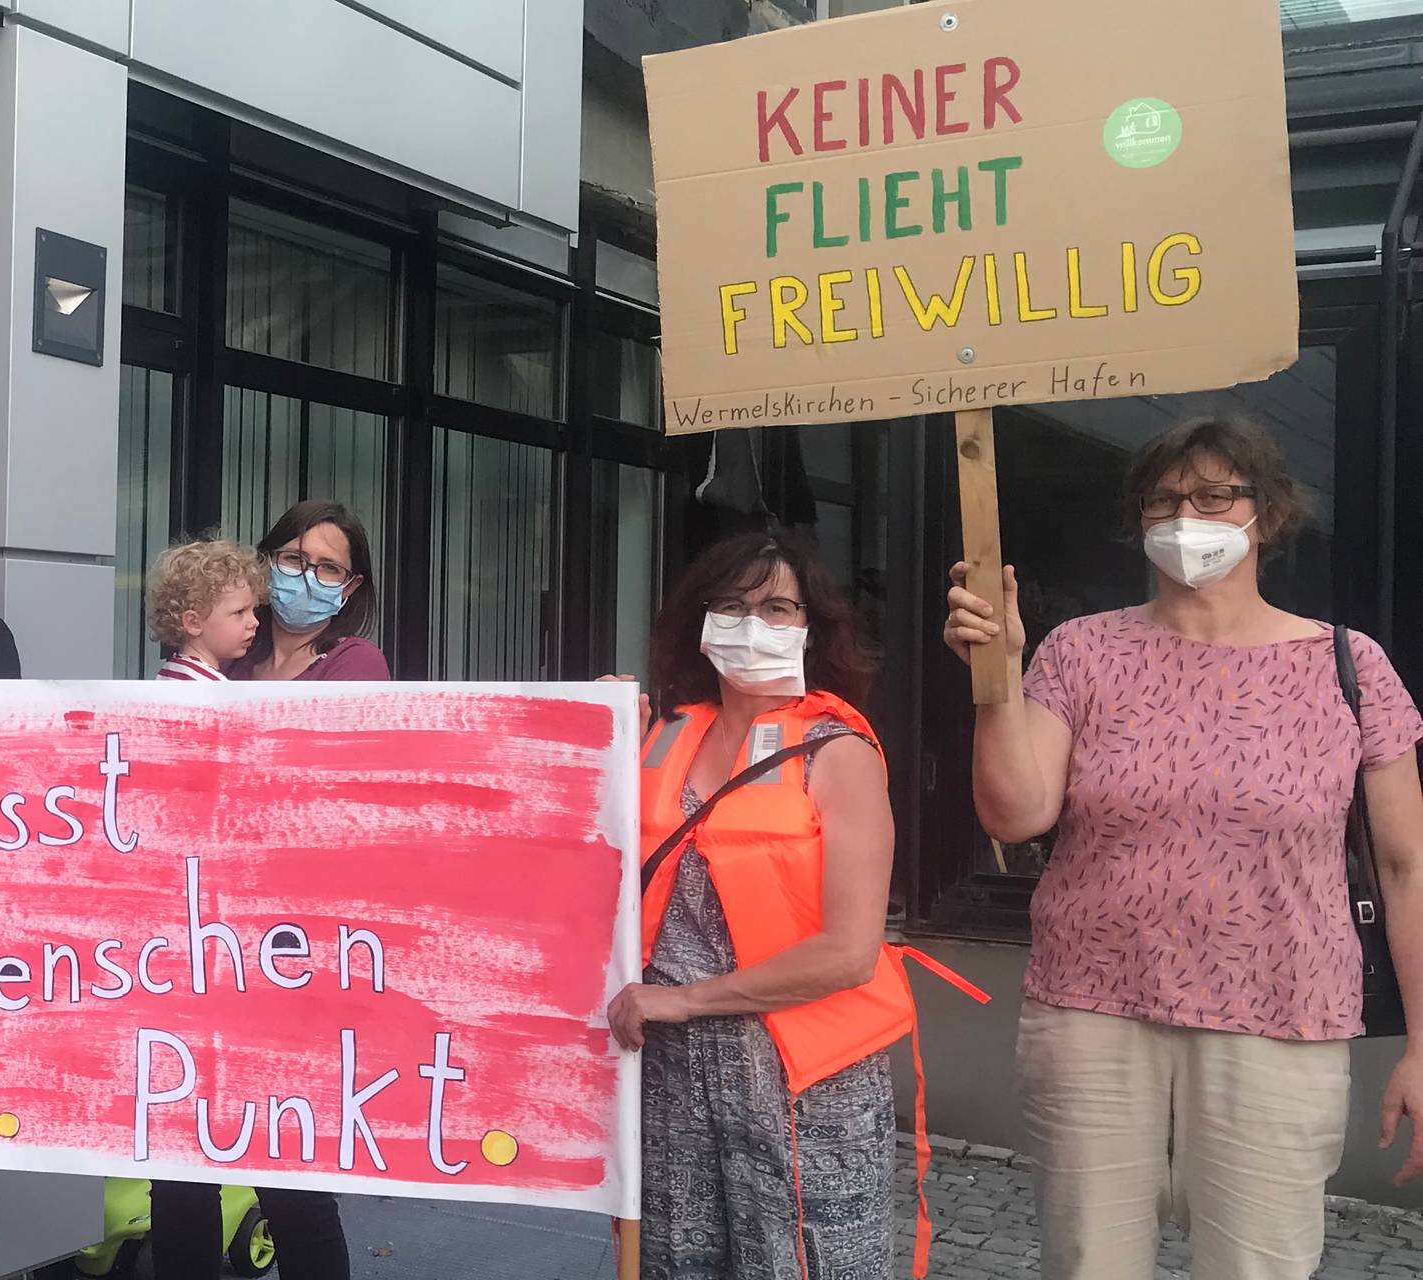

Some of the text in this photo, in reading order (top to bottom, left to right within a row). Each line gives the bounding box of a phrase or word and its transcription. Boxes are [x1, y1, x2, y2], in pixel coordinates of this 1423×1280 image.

[757, 56, 1023, 163] KEINER
[765, 156, 1023, 258] FLIEHT
[718, 232, 1203, 355] FREIWILLIG
[911, 376, 1027, 407] Sicherer
[1051, 362, 1146, 397] Hafen
[133, 1028, 518, 1176] Punkt.
